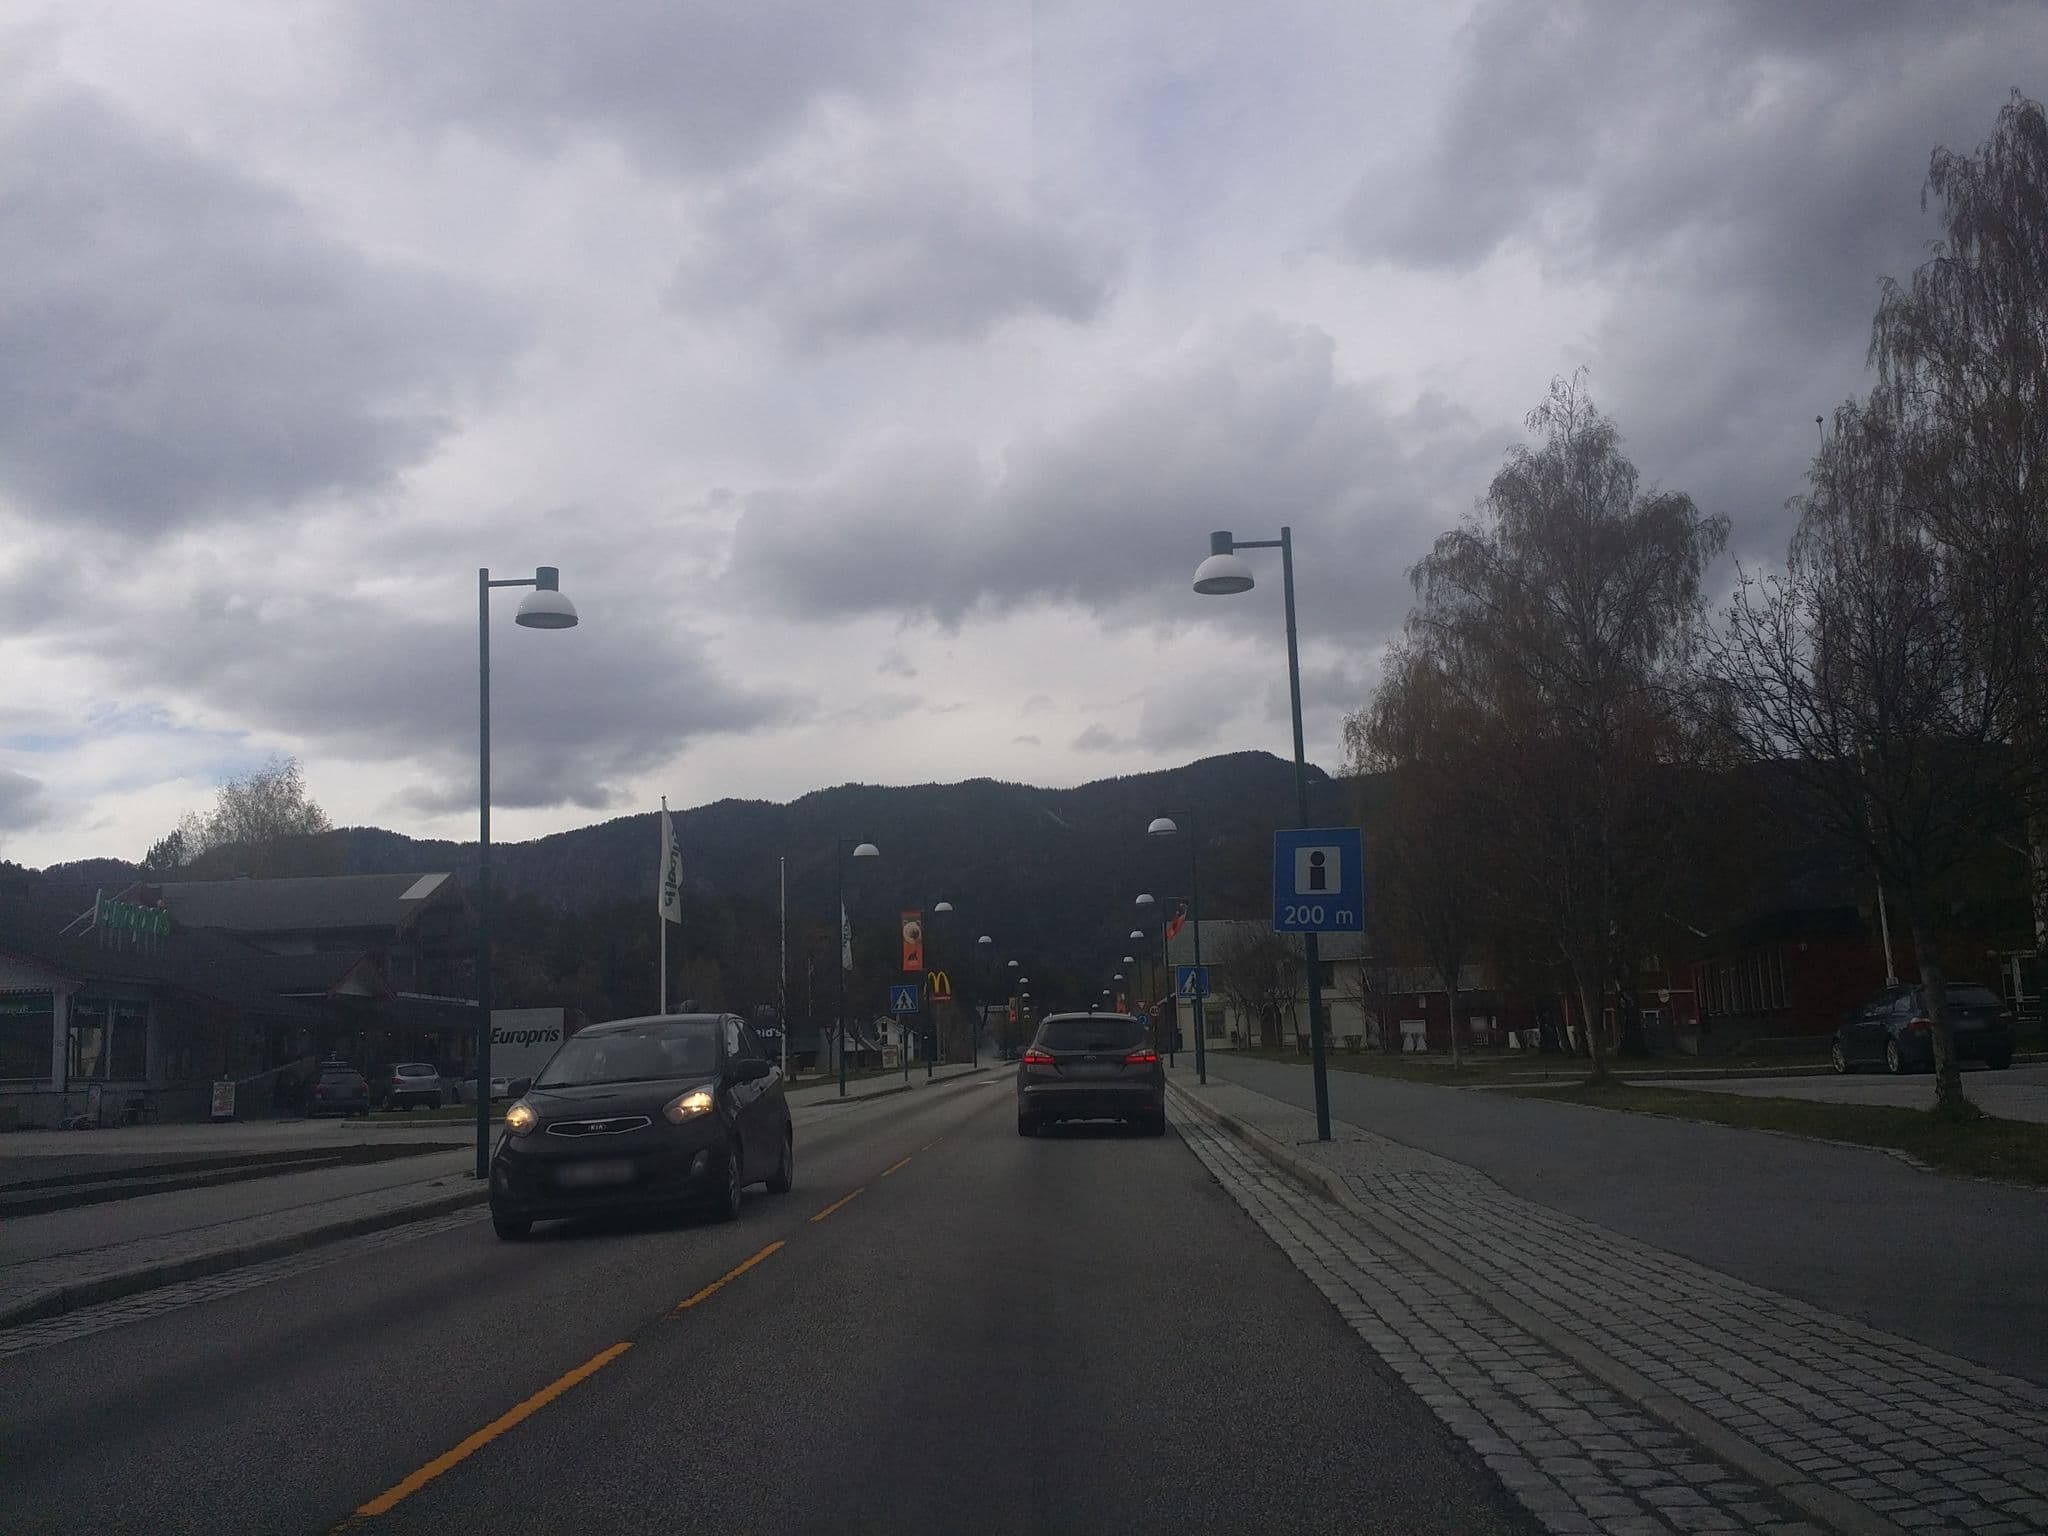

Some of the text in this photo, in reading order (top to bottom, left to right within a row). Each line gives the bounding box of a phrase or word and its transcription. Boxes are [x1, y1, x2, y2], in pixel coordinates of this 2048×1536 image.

[1284, 905, 1353, 924] 200 m
[490, 1025, 560, 1048] Europris
